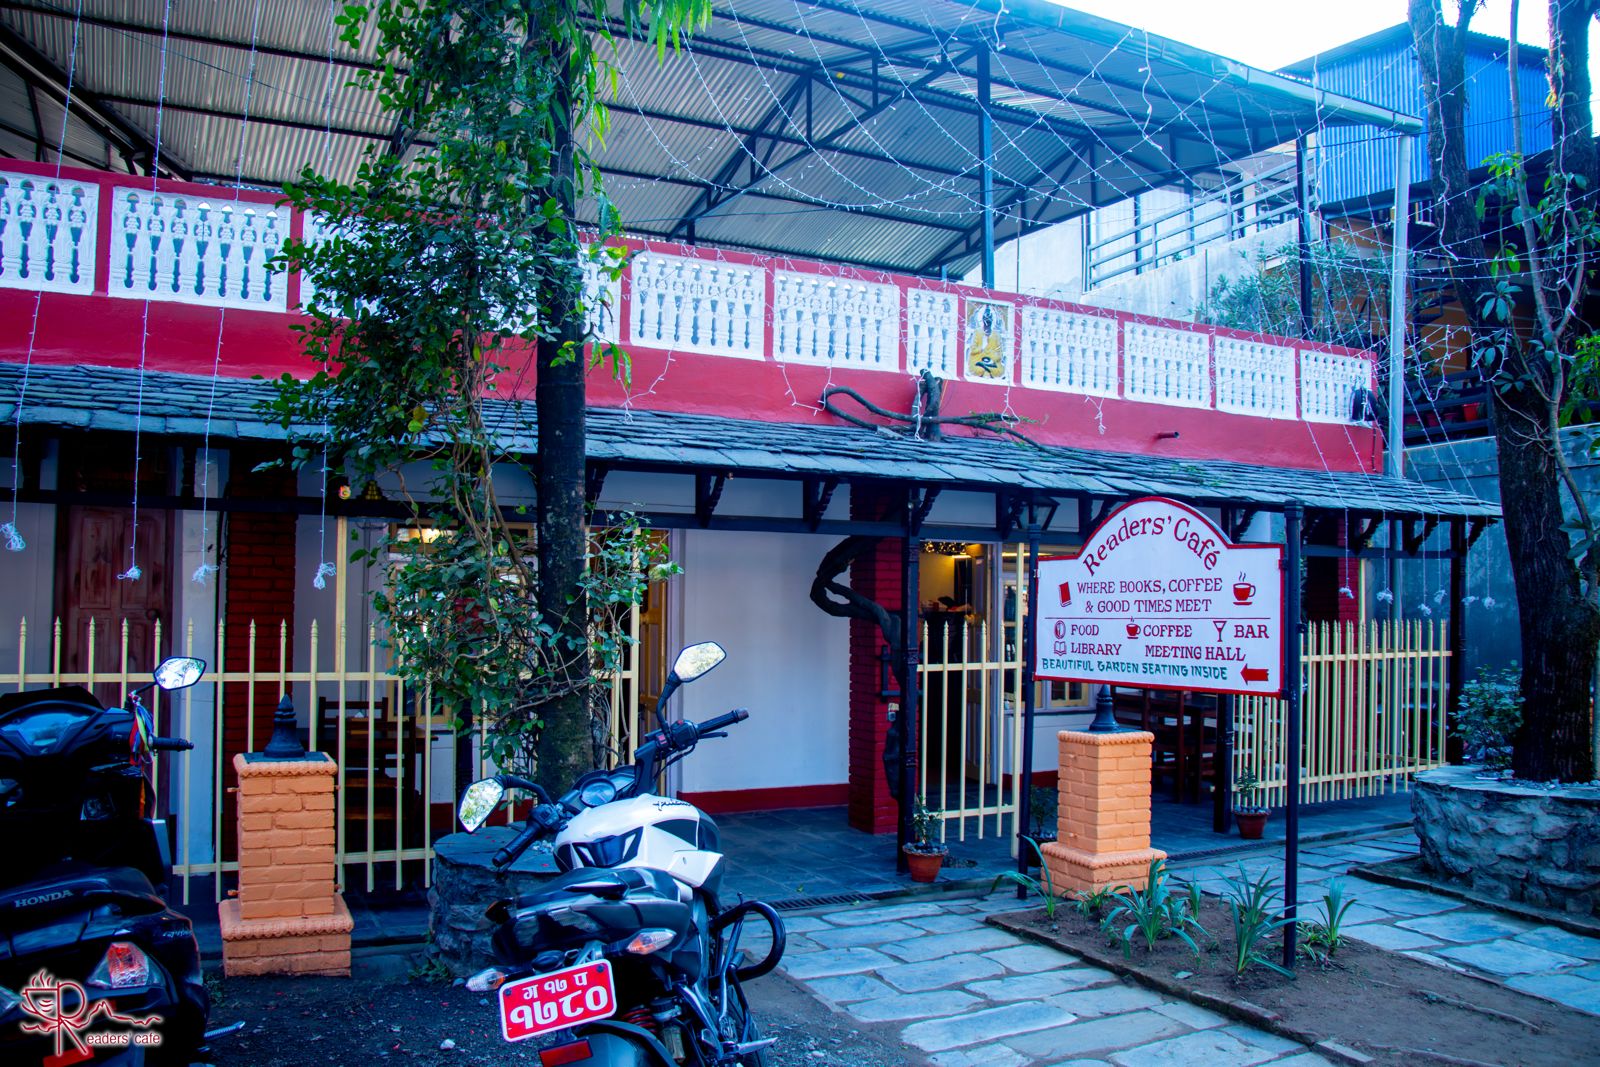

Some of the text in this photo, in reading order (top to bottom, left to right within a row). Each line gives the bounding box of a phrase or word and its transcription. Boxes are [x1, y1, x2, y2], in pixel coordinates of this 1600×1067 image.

[1082, 515, 1221, 577] Readers' Café
[1077, 577, 1223, 594] WHERE BOOKS, COFFEE
[1085, 599, 1213, 613] & GOOD TIMES MEET
[1070, 624, 1100, 636] FOOD
[1143, 624, 1193, 638] COFFEE
[1234, 624, 1270, 639] BAR
[1070, 643, 1122, 656] LIBRARY
[1144, 644, 1246, 662] MEETING HALL
[1042, 658, 1228, 680] BEAUTIFUL GARDEN SEATING INSIDE
[14, 889, 74, 908] HONDA
